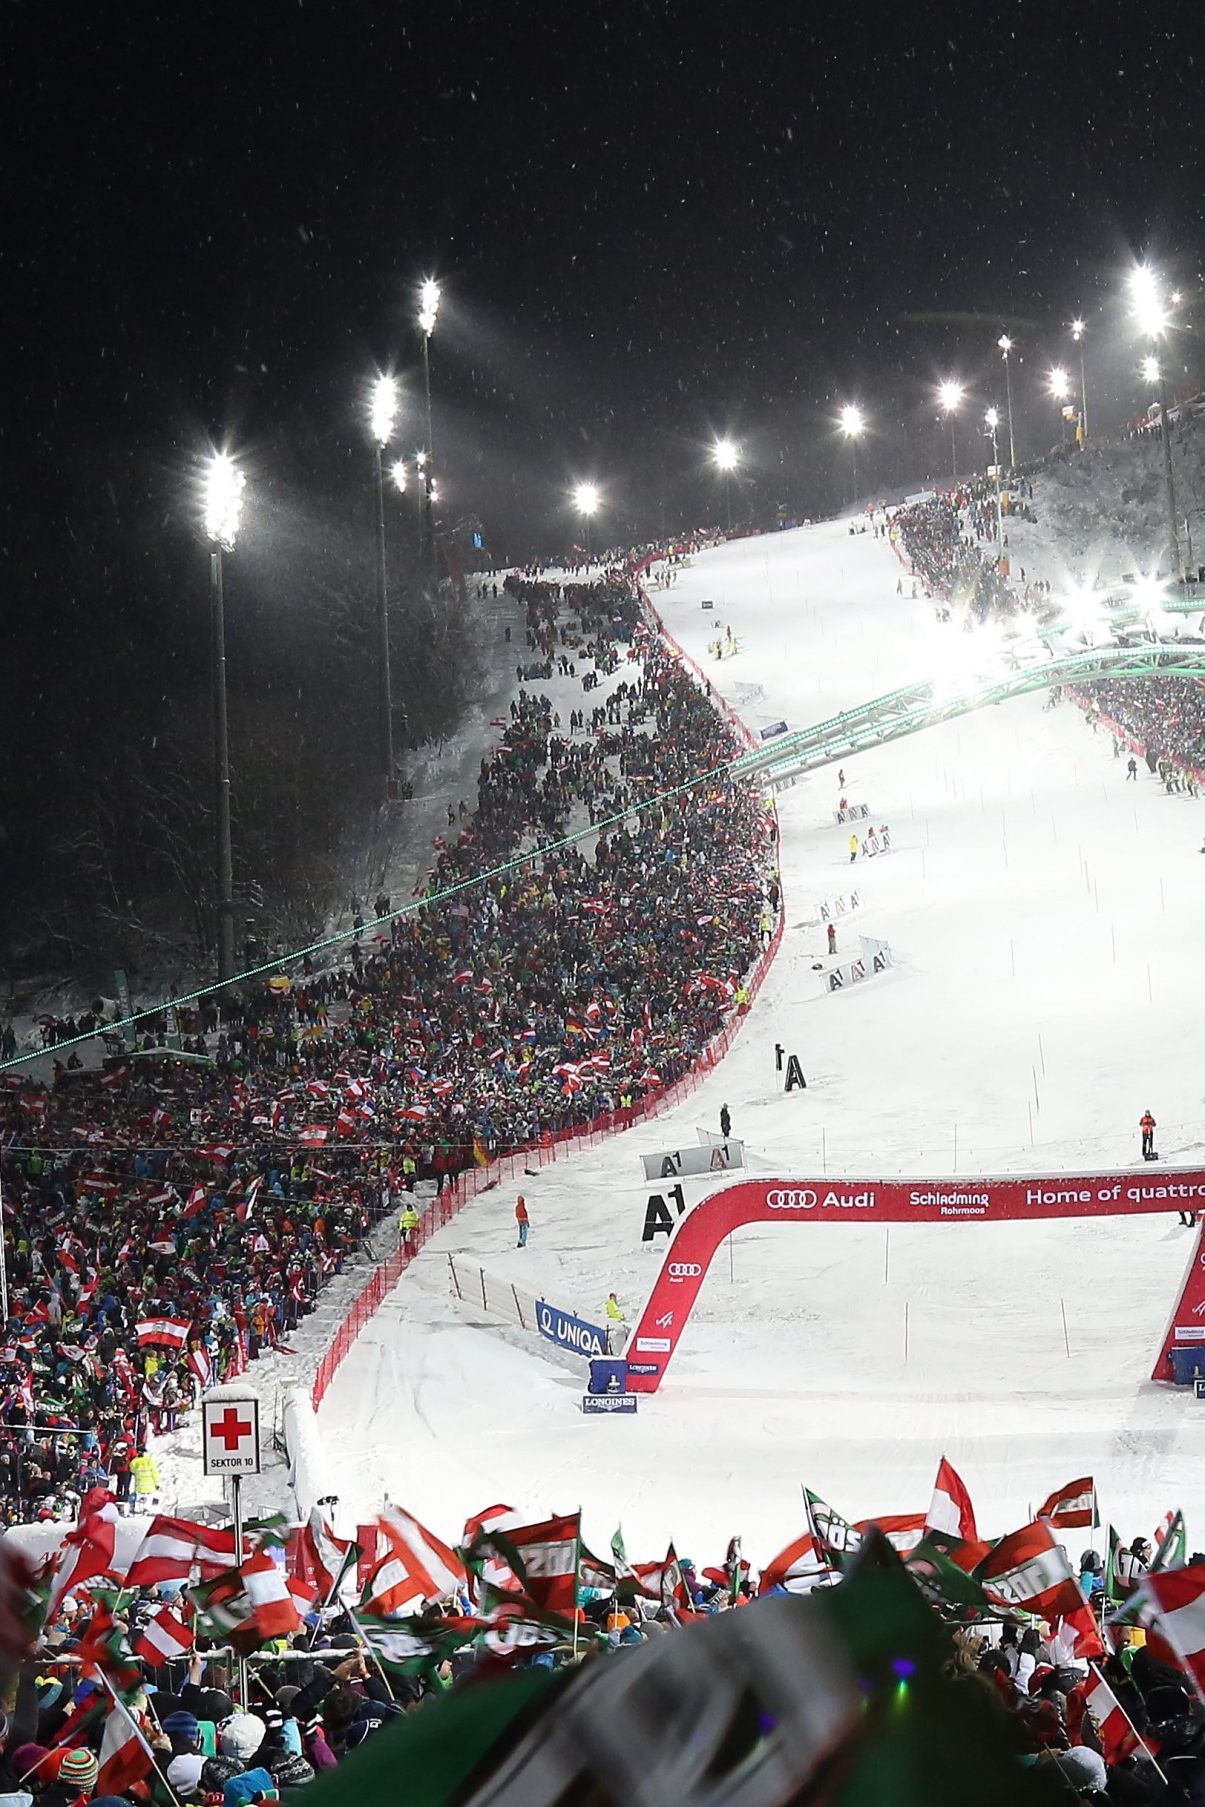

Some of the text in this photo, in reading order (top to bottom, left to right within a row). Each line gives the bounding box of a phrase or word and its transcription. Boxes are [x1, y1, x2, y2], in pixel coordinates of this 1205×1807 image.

[829, 951, 886, 991] A1 A1 A1
[661, 1144, 730, 1178] A1 A1
[822, 1191, 876, 1208] Audi
[1026, 1188, 1092, 1205] Home
[1097, 1185, 1122, 1201] of
[642, 1184, 686, 1242] A1
[940, 1206, 986, 1215] Rohrmoos
[557, 1318, 603, 1356] UNIQA
[585, 1397, 635, 1407] LONGINES
[210, 1457, 254, 1468] SEKTOR 10
